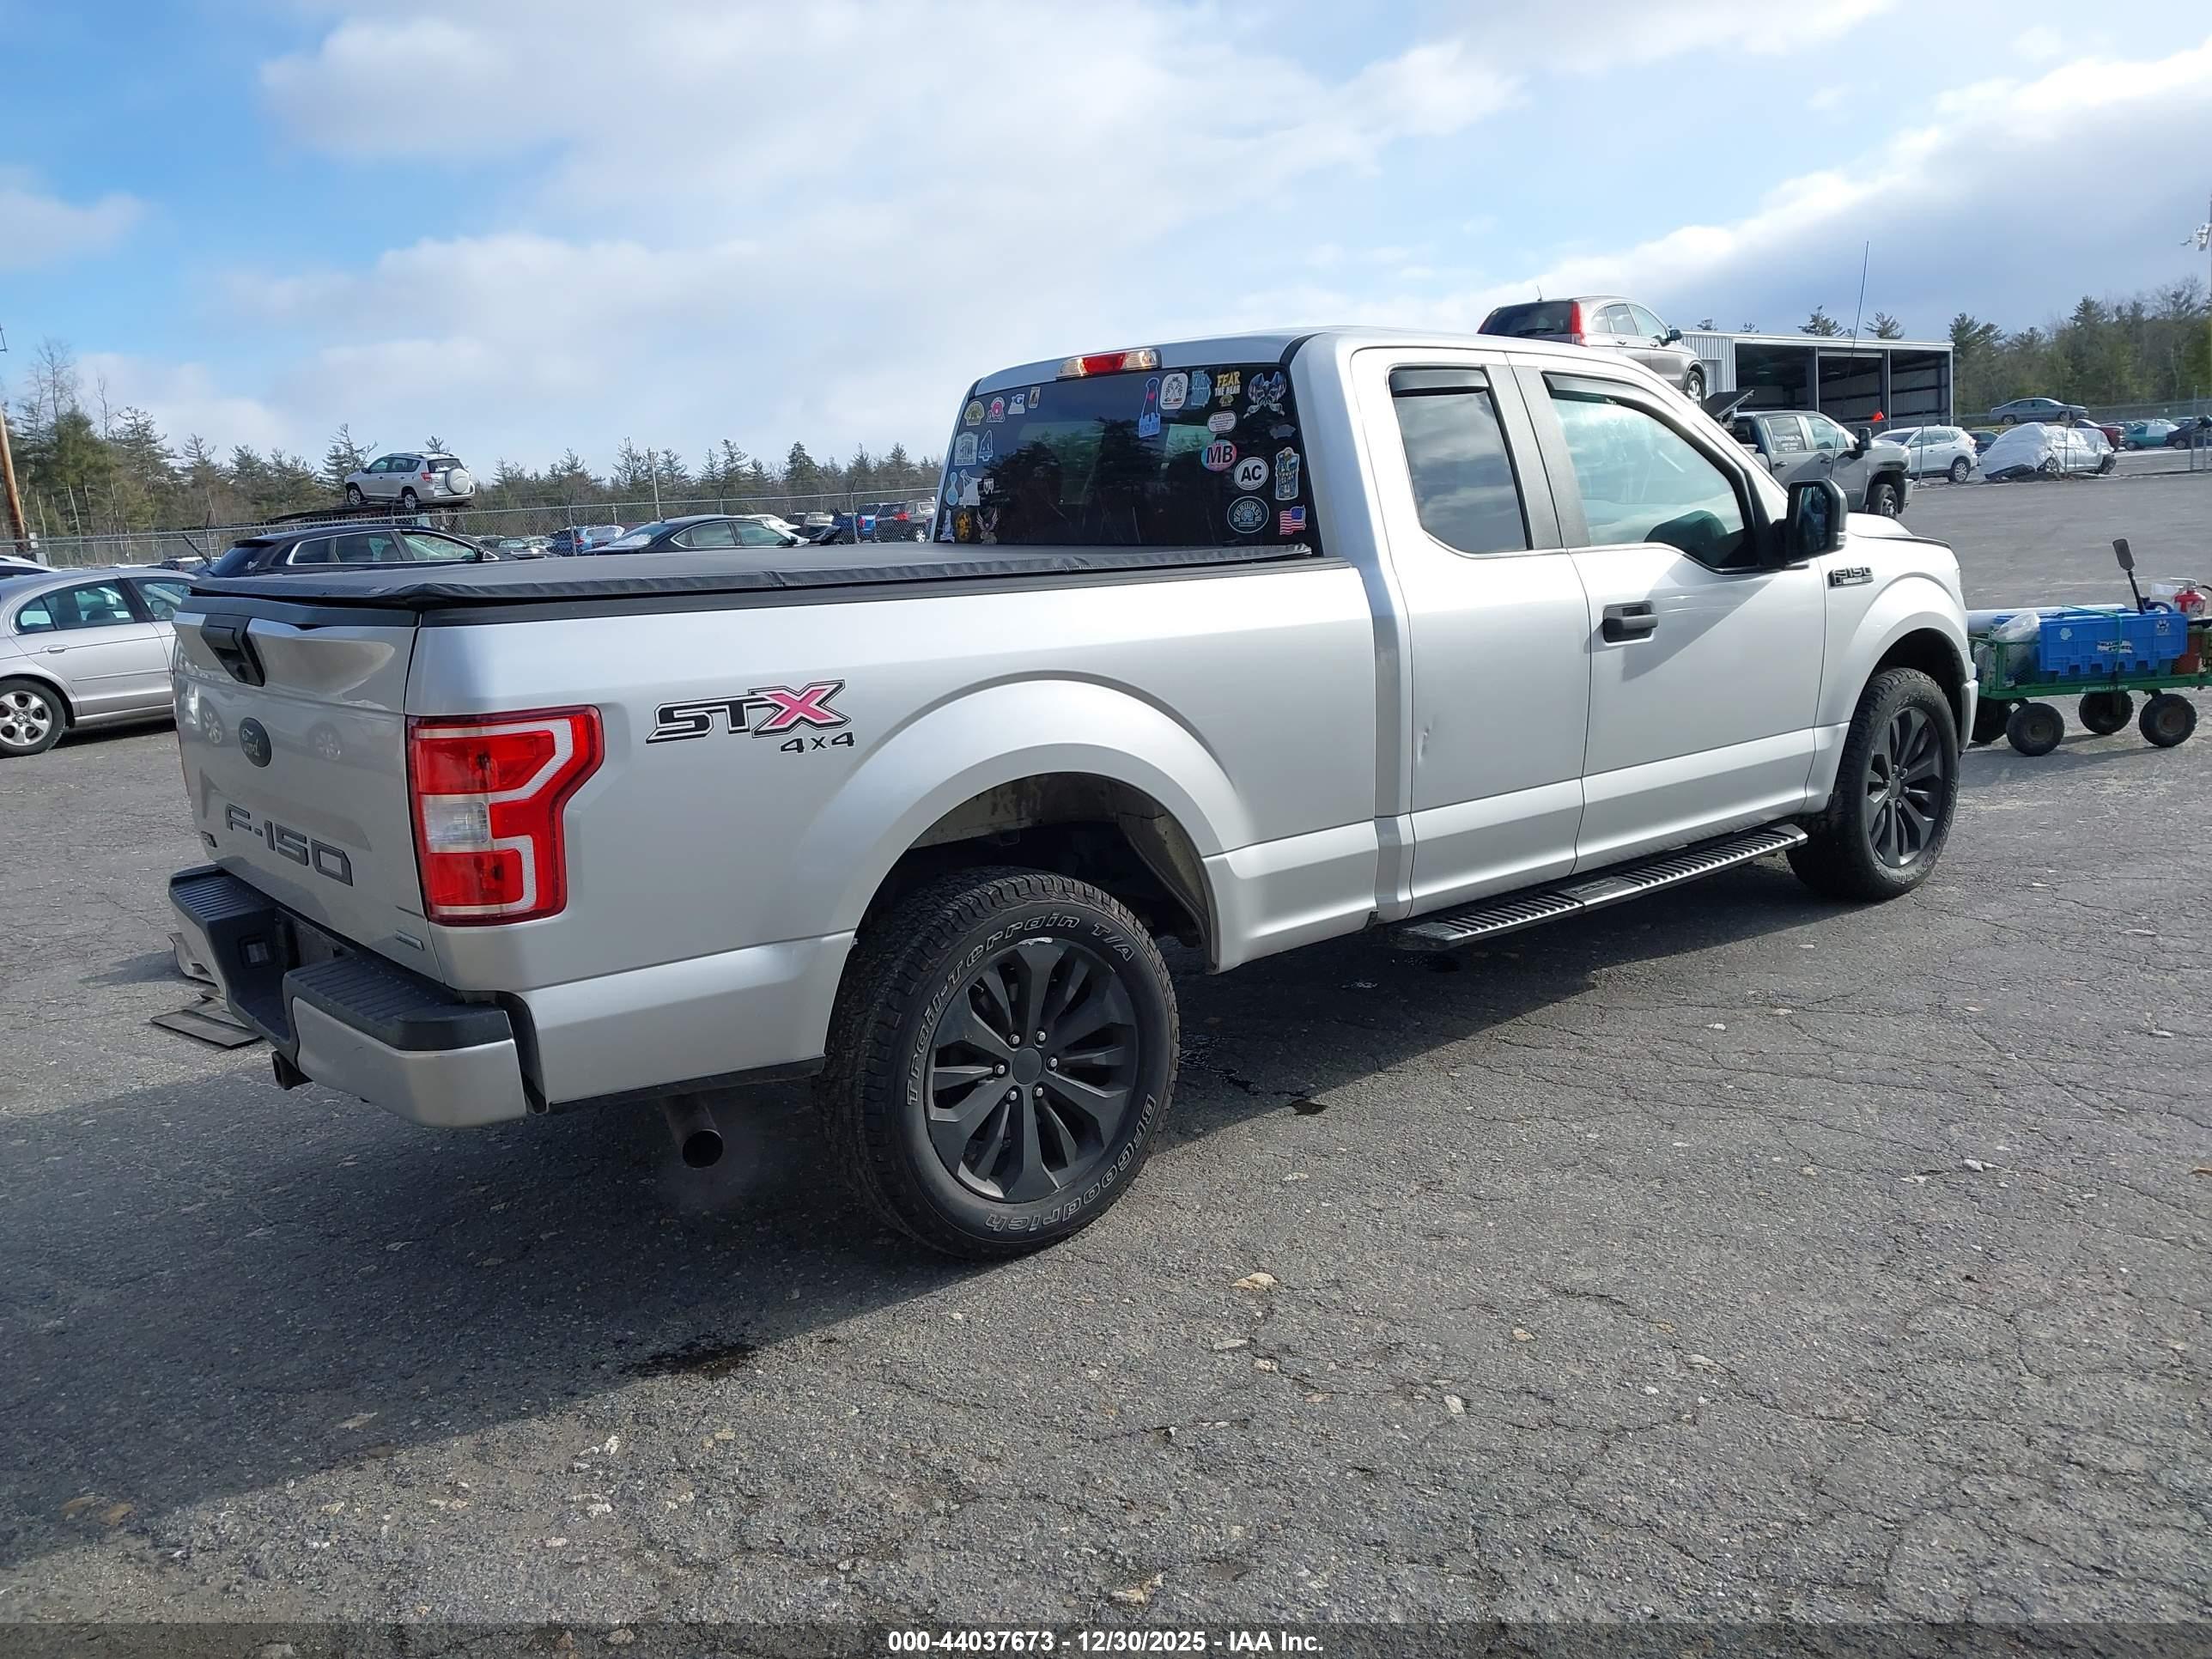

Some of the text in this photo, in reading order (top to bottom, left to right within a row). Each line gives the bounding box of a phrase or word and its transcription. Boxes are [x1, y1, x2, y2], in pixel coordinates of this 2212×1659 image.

[1216, 371, 1241, 387] FEAR
[1214, 386, 1225, 397] THE
[1206, 445, 1233, 464] MB
[1241, 465, 1262, 482] AC
[1237, 502, 1261, 517] BRUINS
[646, 679, 852, 744] STX
[241, 728, 260, 757] Ford
[225, 803, 354, 886] F-150
[907, 913, 1137, 1105] Trail-Terrain T/A
[985, 1093, 1157, 1232] BFGoodrich
